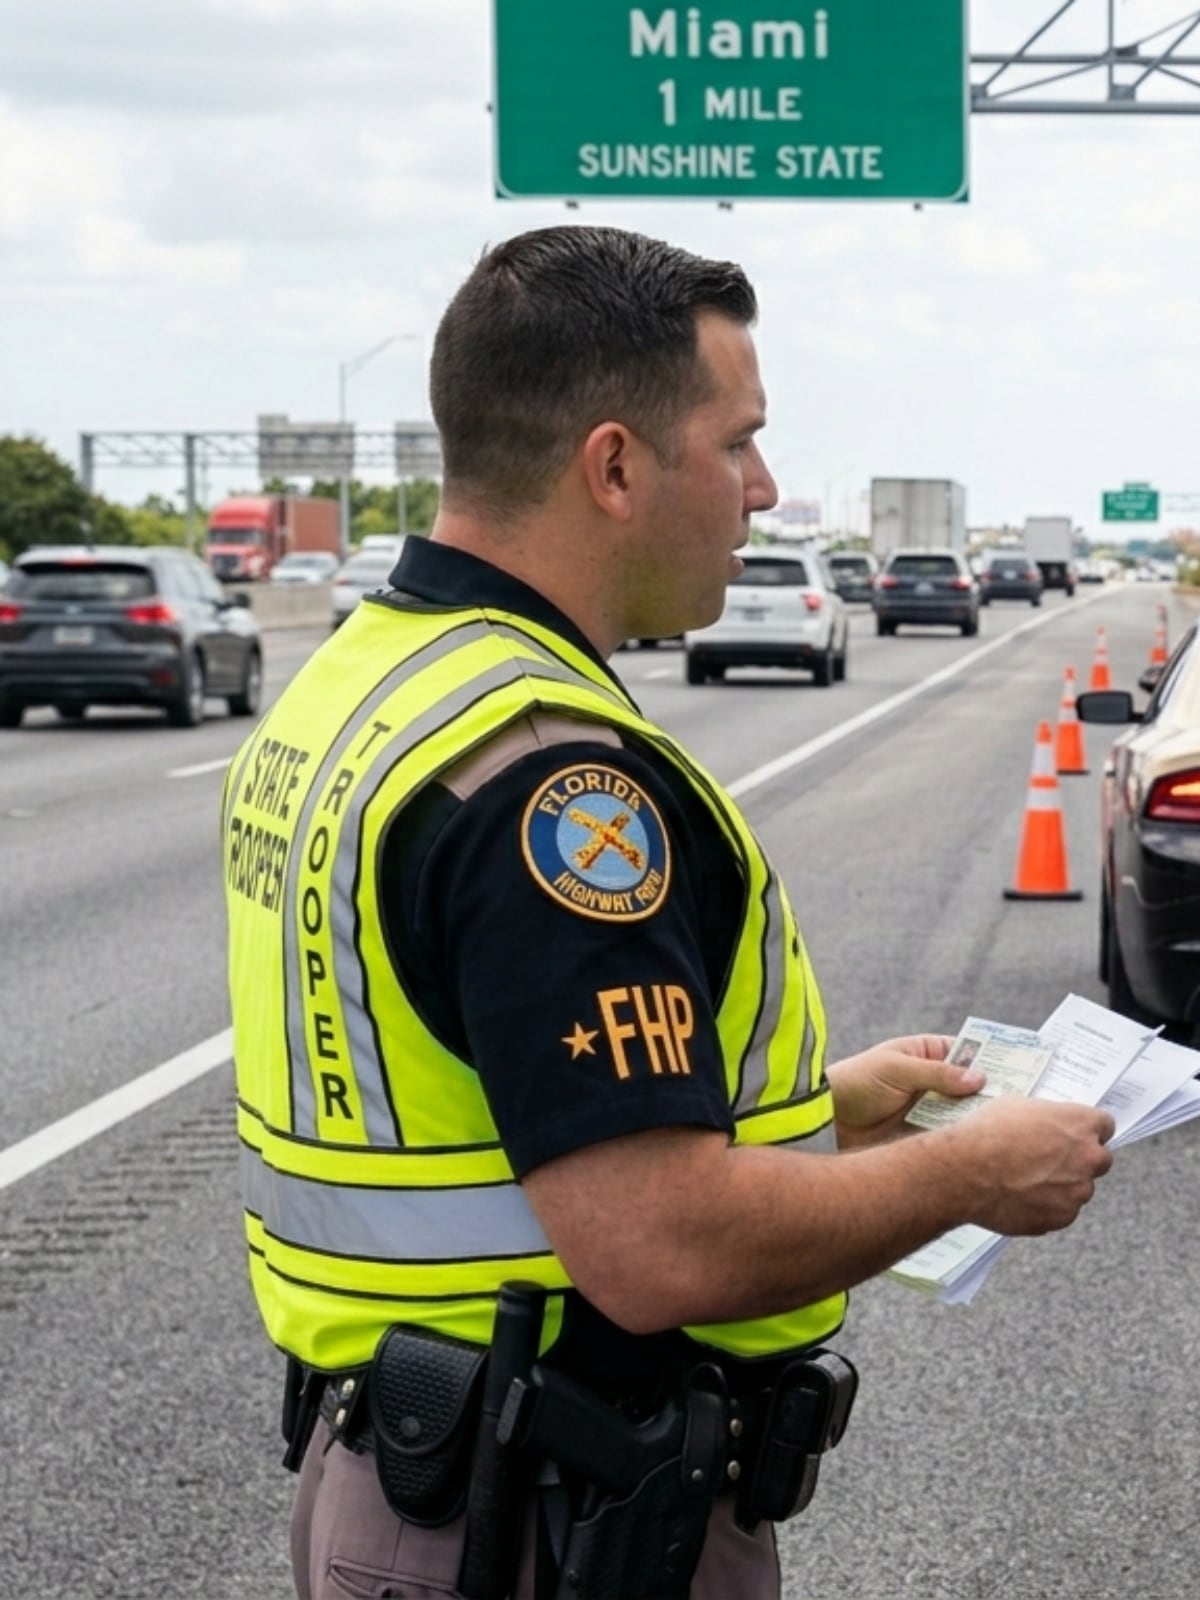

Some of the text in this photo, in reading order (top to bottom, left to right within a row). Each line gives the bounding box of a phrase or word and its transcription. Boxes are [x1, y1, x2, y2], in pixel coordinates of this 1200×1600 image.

[630, 9, 828, 58] Miami
[658, 79, 802, 125] 1 MILE
[579, 144, 883, 179] SUNSHINE STATE
[243, 737, 309, 821] STATE
[539, 771, 641, 816] FLORIDA
[301, 720, 391, 1120] TROOPER
[597, 984, 694, 1080] FHP
